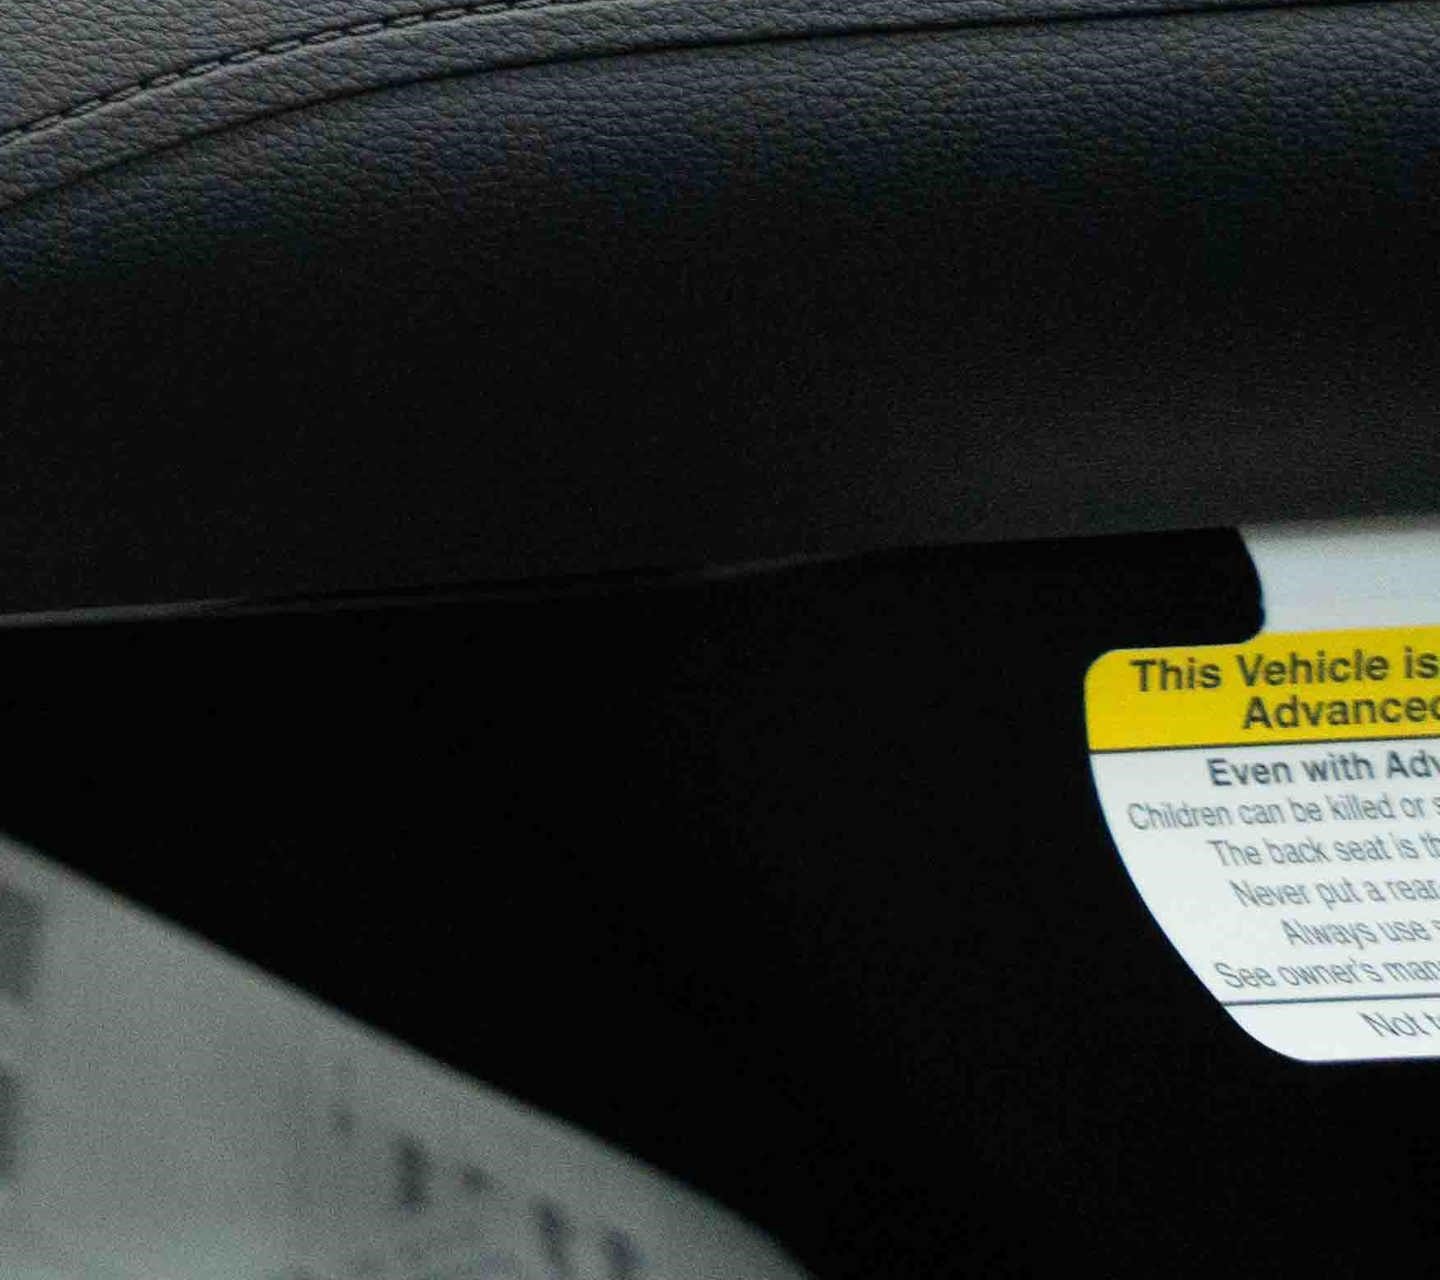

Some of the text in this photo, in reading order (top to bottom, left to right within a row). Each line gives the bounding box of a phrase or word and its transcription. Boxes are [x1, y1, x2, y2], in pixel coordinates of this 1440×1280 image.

[1130, 645, 1439, 692] This Vehicle is
[1207, 754, 1376, 787] Even with
[1127, 794, 1426, 831] Children can be killed or
[1210, 836, 1419, 868] The back seat is
[1228, 877, 1386, 912] Never put a
[1280, 917, 1432, 949] Always use
[1214, 957, 1384, 990] See owner's
[1360, 1011, 1430, 1039] Not
